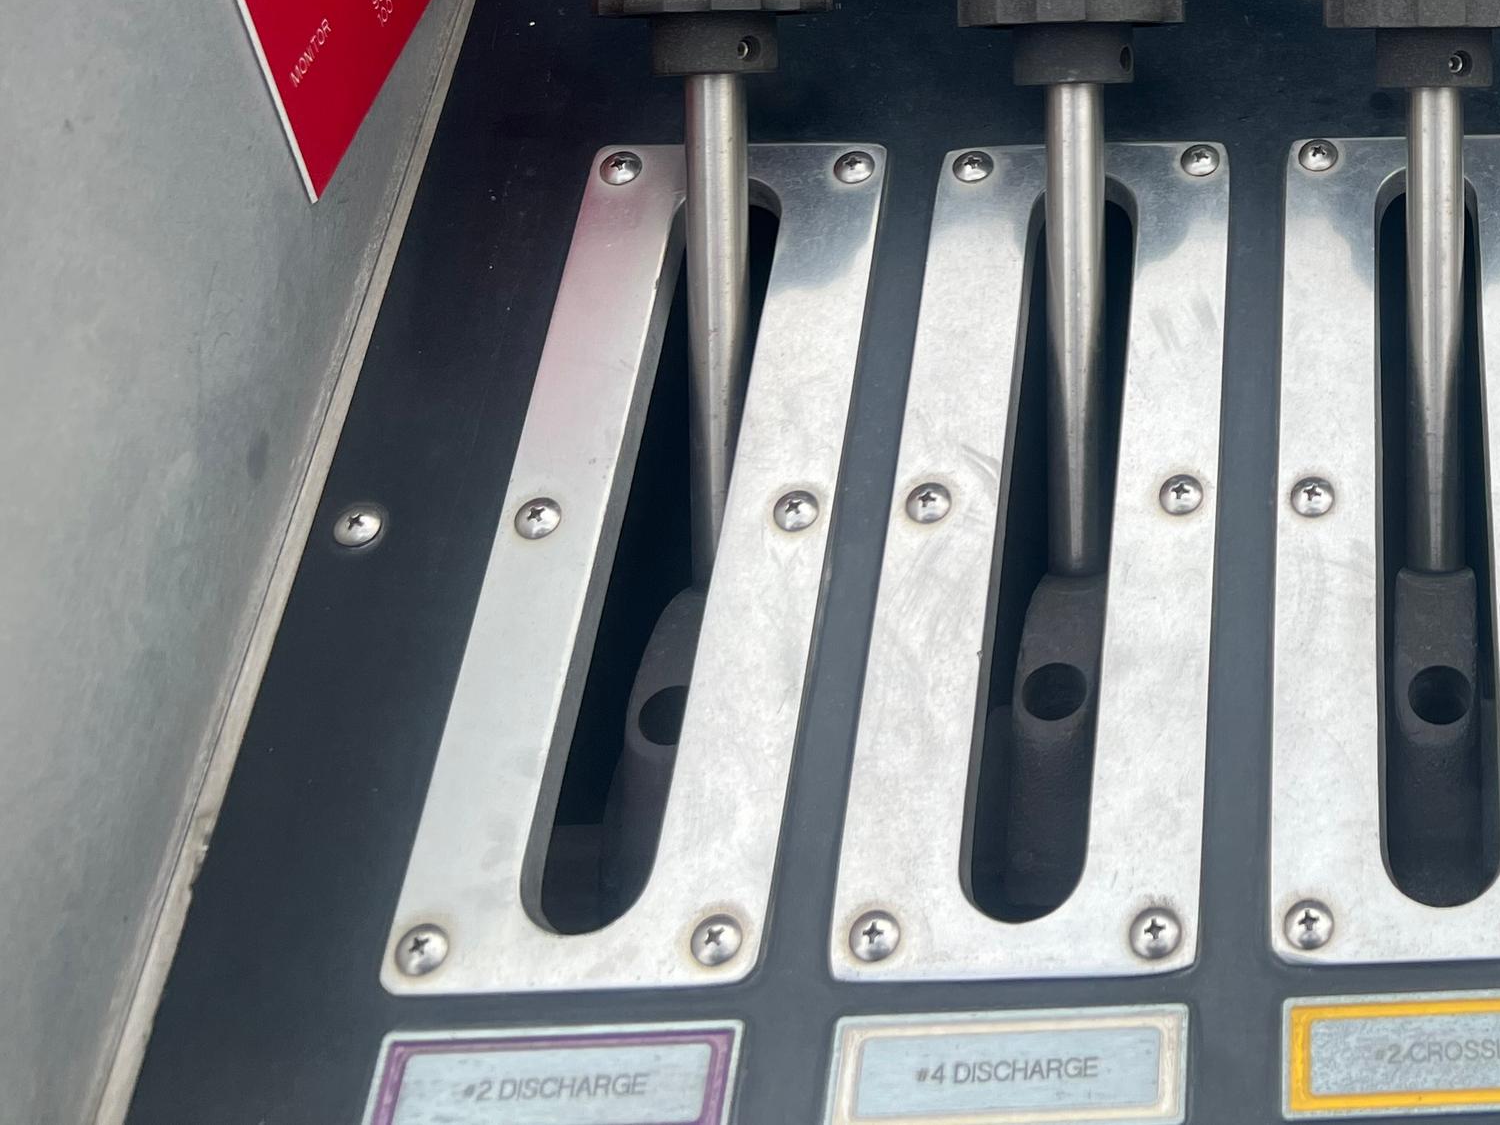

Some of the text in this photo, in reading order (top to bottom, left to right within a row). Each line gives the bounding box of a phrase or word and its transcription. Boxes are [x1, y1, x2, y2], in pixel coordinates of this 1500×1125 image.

[289, 17, 332, 88] MONITOR
[916, 1056, 1100, 1085] #4 DISCHARGE
[499, 1072, 650, 1101] DISCHARGE
